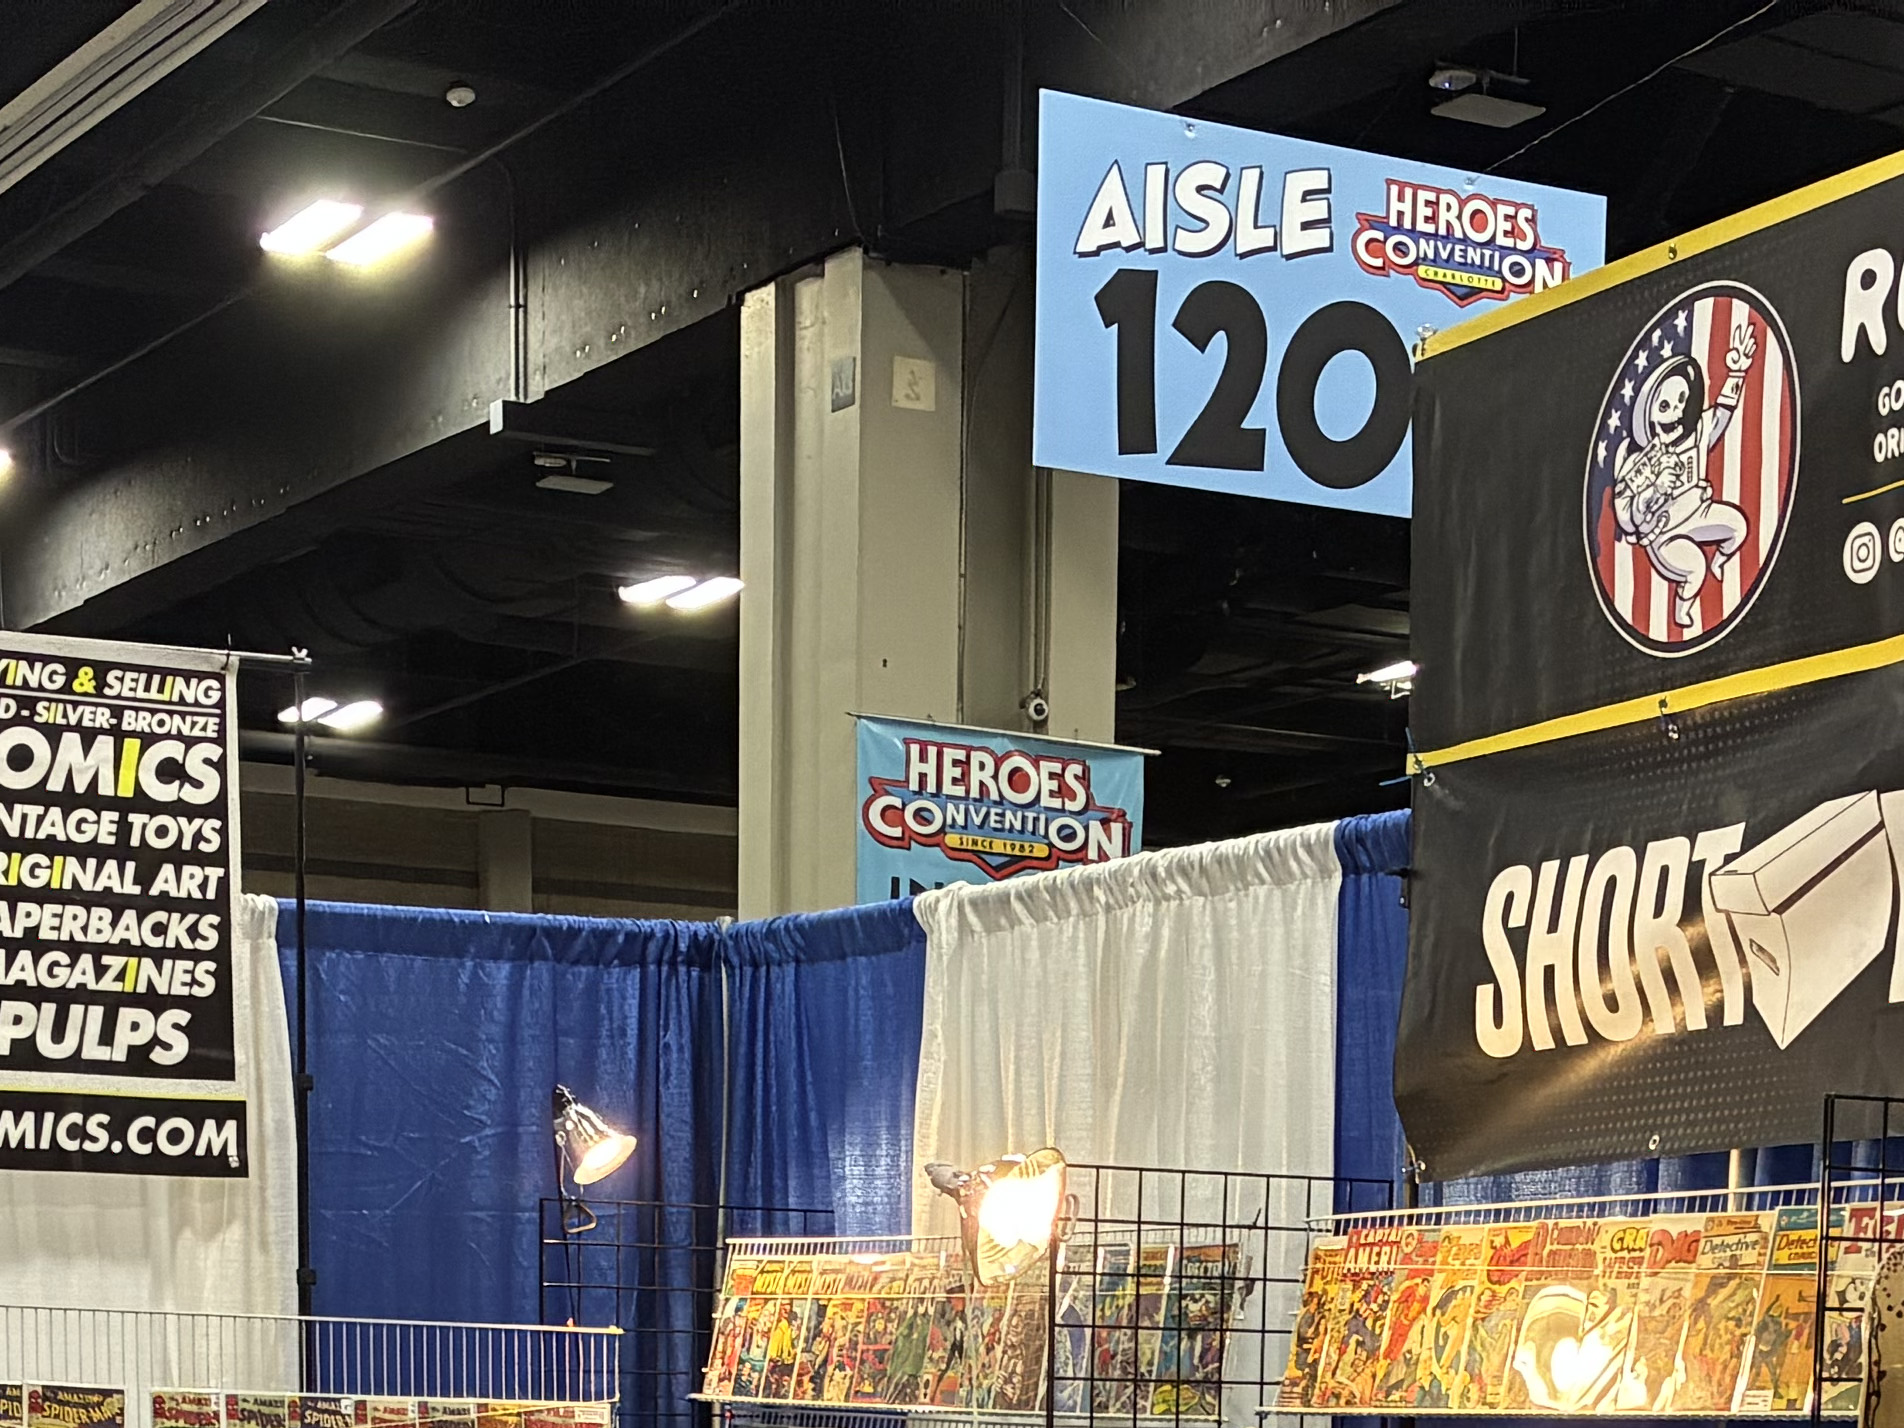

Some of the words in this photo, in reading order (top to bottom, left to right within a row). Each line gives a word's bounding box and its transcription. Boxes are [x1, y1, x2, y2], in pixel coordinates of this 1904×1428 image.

[1073, 160, 1333, 258] AISLE
[1389, 184, 1535, 251] HEROES
[1357, 229, 1564, 295] CONVENTION
[1423, 268, 1503, 288] CHARLOTTE
[1094, 268, 1414, 489] 120
[72, 665, 97, 695] &
[102, 669, 222, 704] SELLING
[121, 709, 220, 738] BRONZE
[908, 743, 1087, 812] HEROES
[128, 812, 222, 854] TOYS
[867, 795, 1124, 860] CONVENTION
[958, 835, 995, 851] SINCE
[1002, 840, 1036, 855] 1982
[149, 861, 225, 902] ART
[1472, 821, 1756, 1058] SHORT
